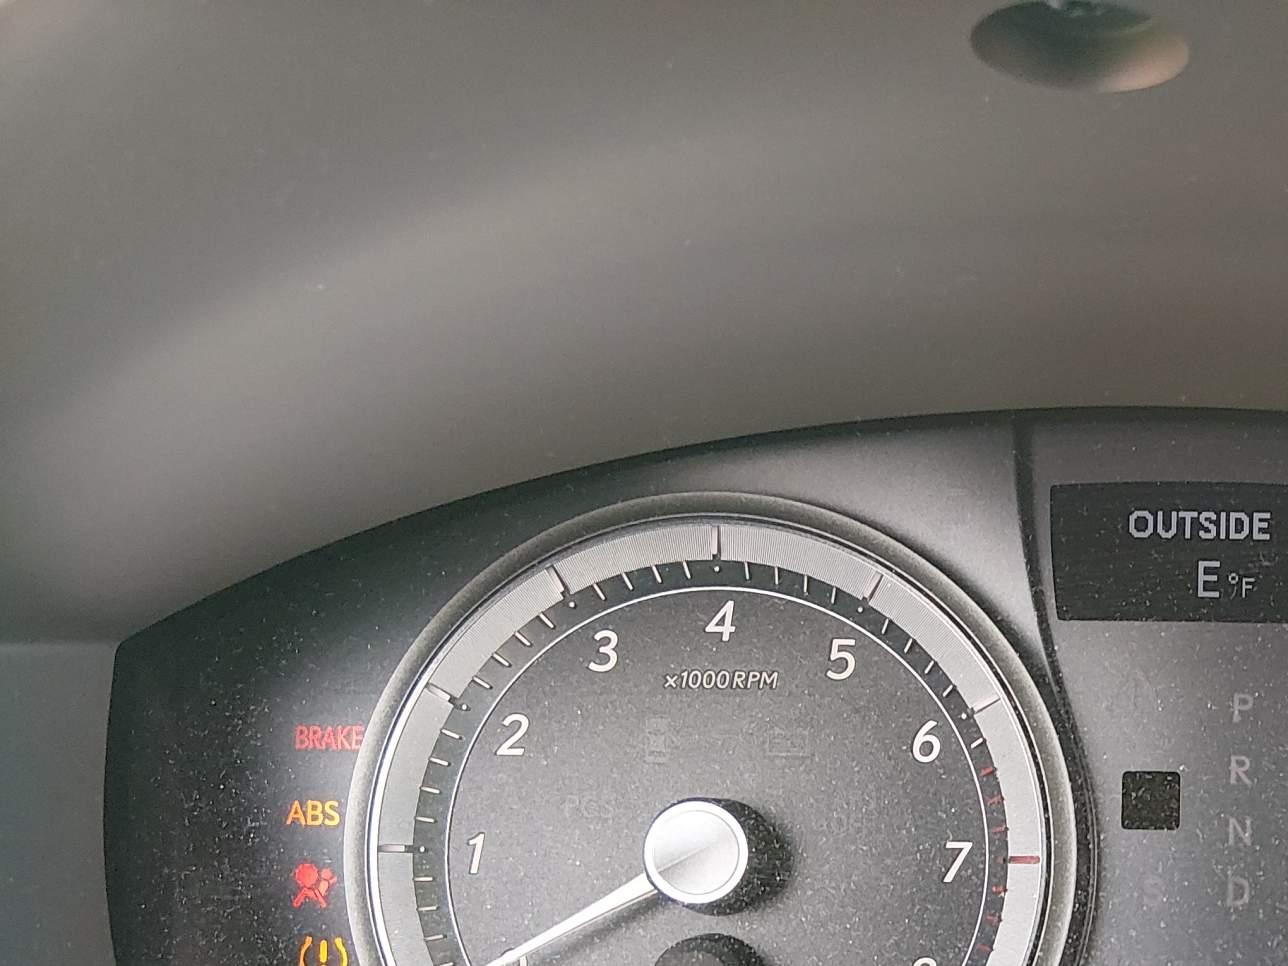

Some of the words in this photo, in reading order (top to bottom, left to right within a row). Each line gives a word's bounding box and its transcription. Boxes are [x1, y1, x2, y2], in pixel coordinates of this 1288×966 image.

[1128, 510, 1271, 541] OUTSIDE
[1196, 560, 1221, 598] E
[705, 600, 736, 642] 4
[588, 629, 619, 672] 3
[826, 638, 857, 680] 5
[1231, 693, 1254, 723] P
[295, 725, 364, 751] BRAKE
[496, 713, 529, 756] 2
[911, 720, 941, 763] 6
[1229, 756, 1252, 786] R
[286, 800, 341, 827] ABS
[1228, 815, 1252, 847] N
[466, 832, 486, 875] 1
[943, 841, 973, 883] 7
[1226, 874, 1250, 906] D
